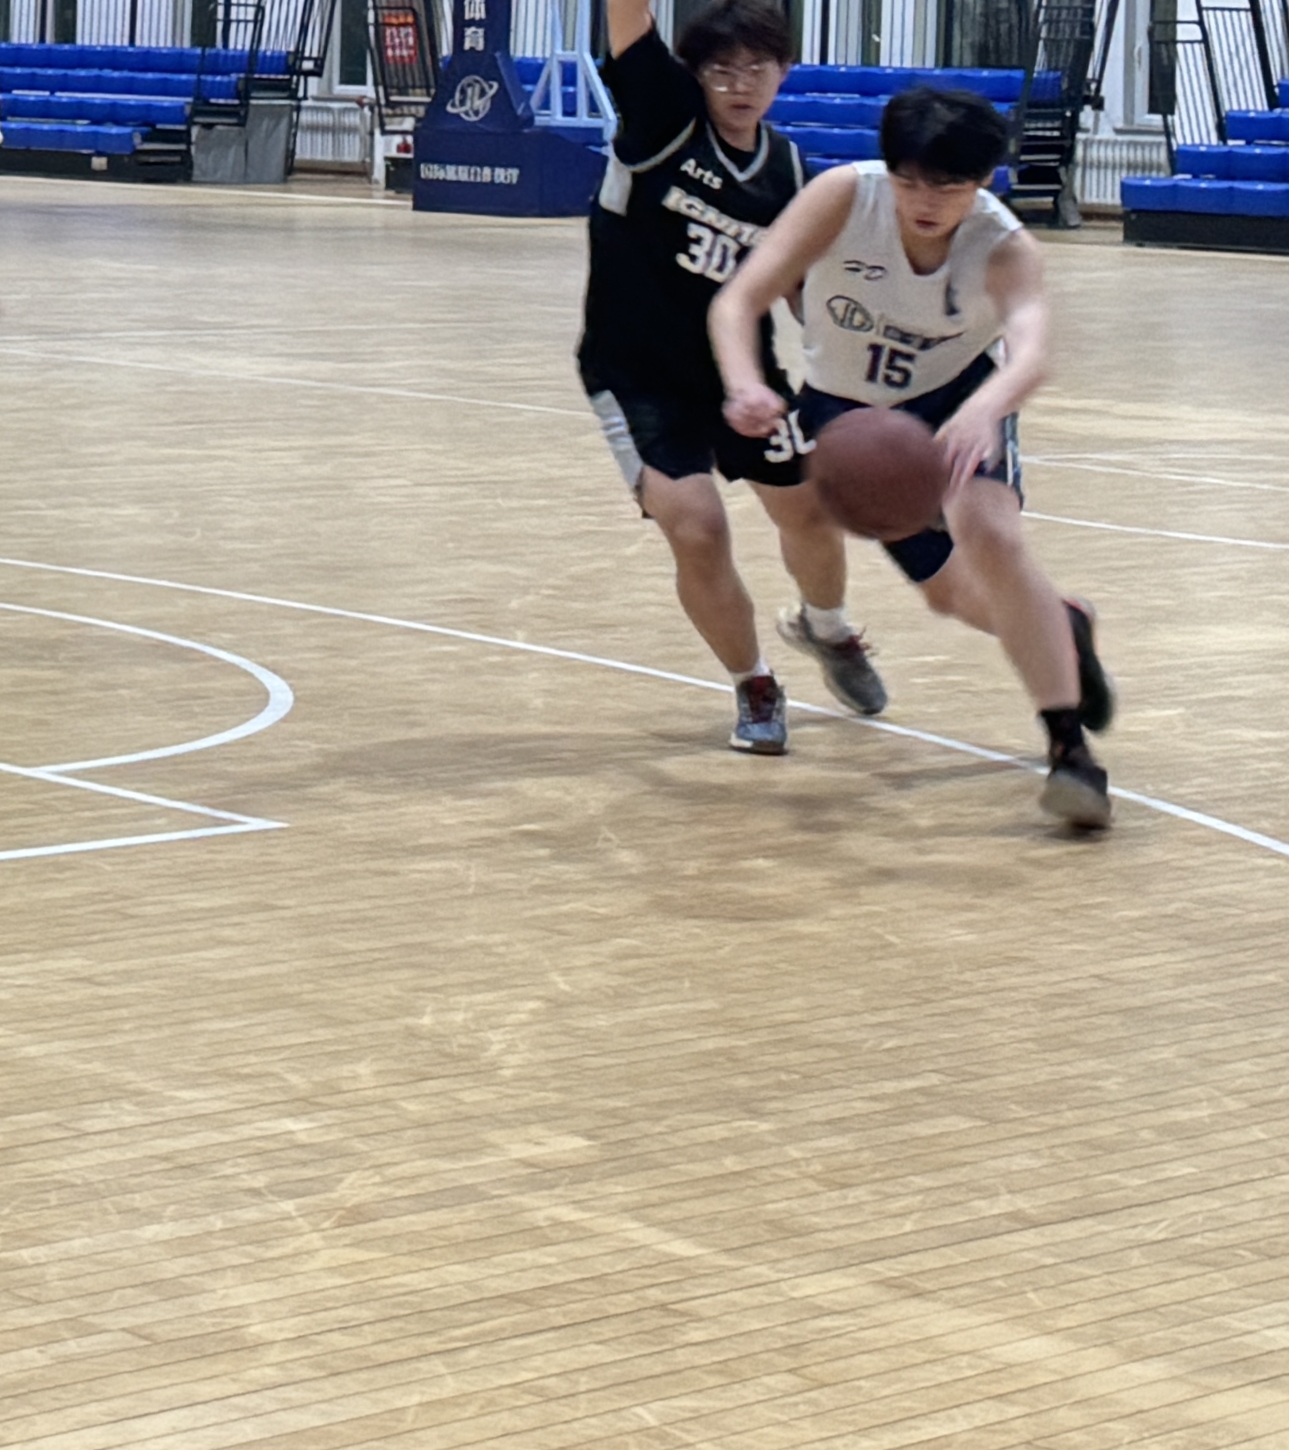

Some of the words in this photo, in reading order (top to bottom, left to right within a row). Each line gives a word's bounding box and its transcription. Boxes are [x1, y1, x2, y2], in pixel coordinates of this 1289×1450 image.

[680, 158, 723, 190] Arts
[675, 222, 741, 283] 30
[865, 344, 916, 389] 15
